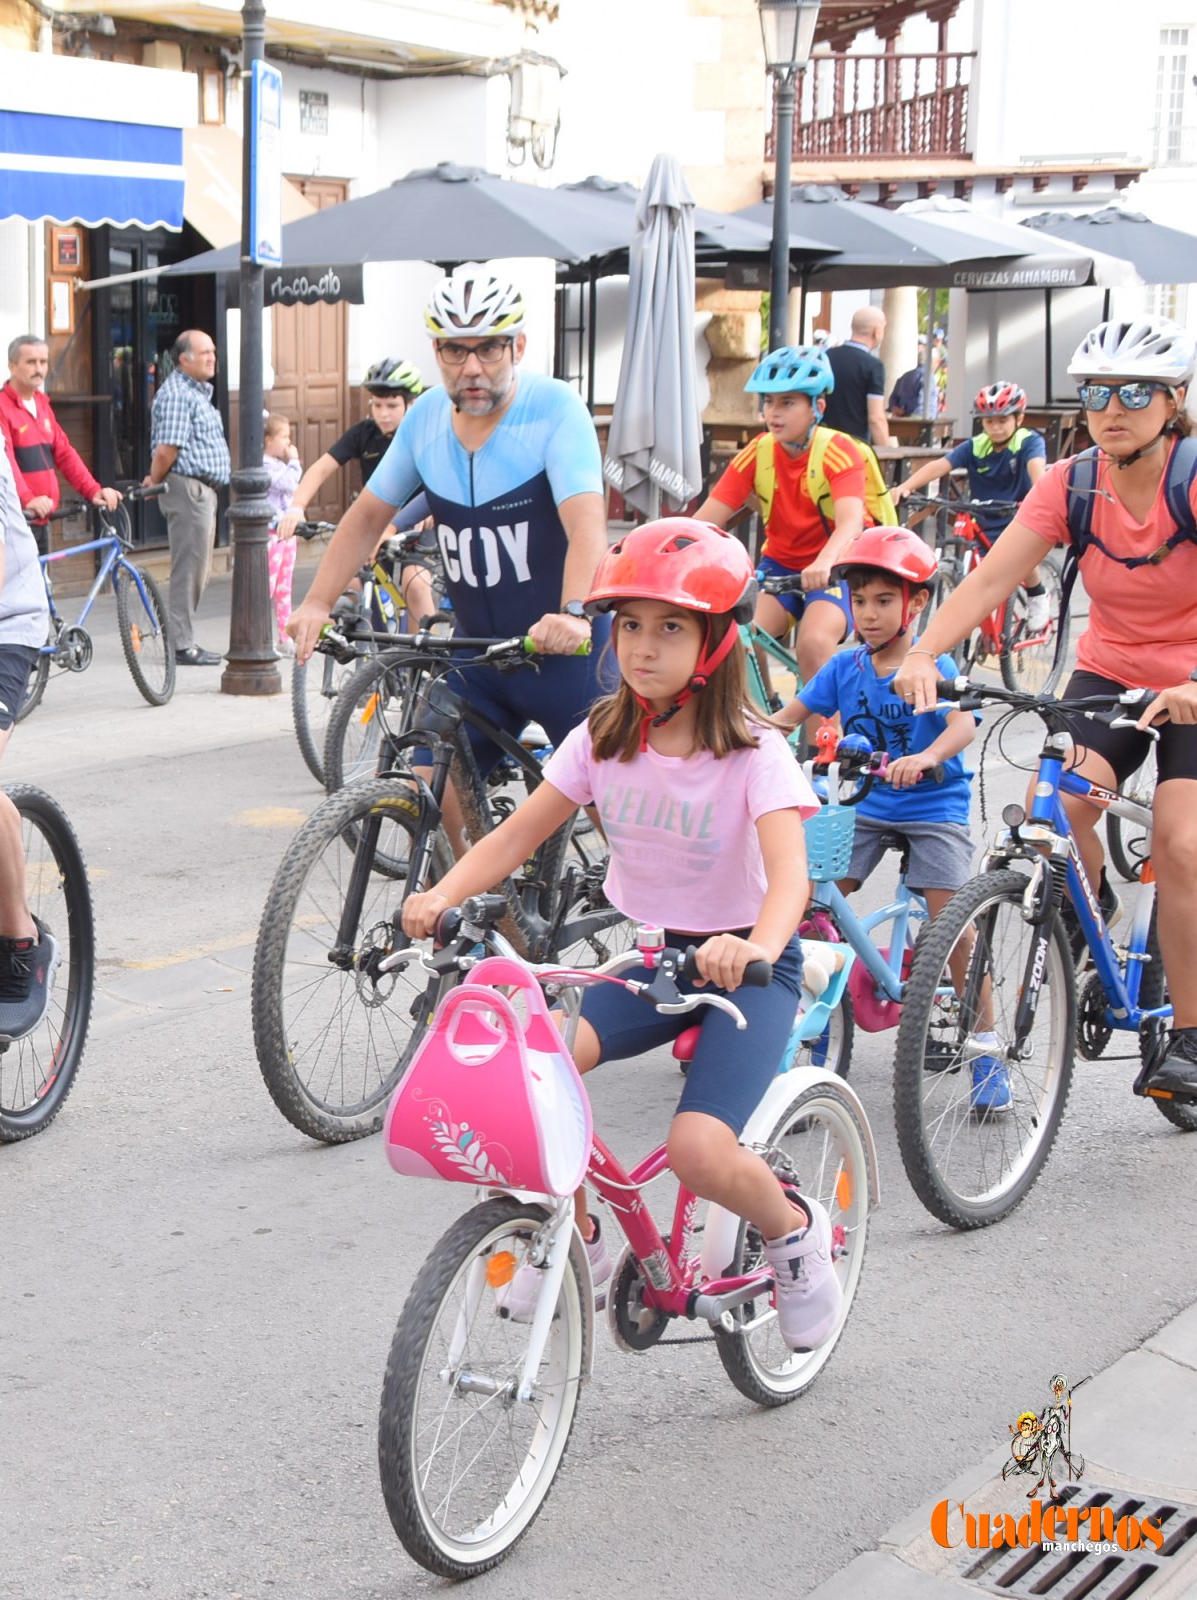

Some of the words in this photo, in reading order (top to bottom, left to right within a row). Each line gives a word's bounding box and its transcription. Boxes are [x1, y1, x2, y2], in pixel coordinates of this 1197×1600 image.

[953, 271, 1009, 286] CERVEZAS
[1011, 268, 1077, 284] ALHAMBRA
[437, 520, 532, 588] COY
[601, 783, 716, 839] BELIEVE
[1029, 936, 1049, 993] ZOOM
